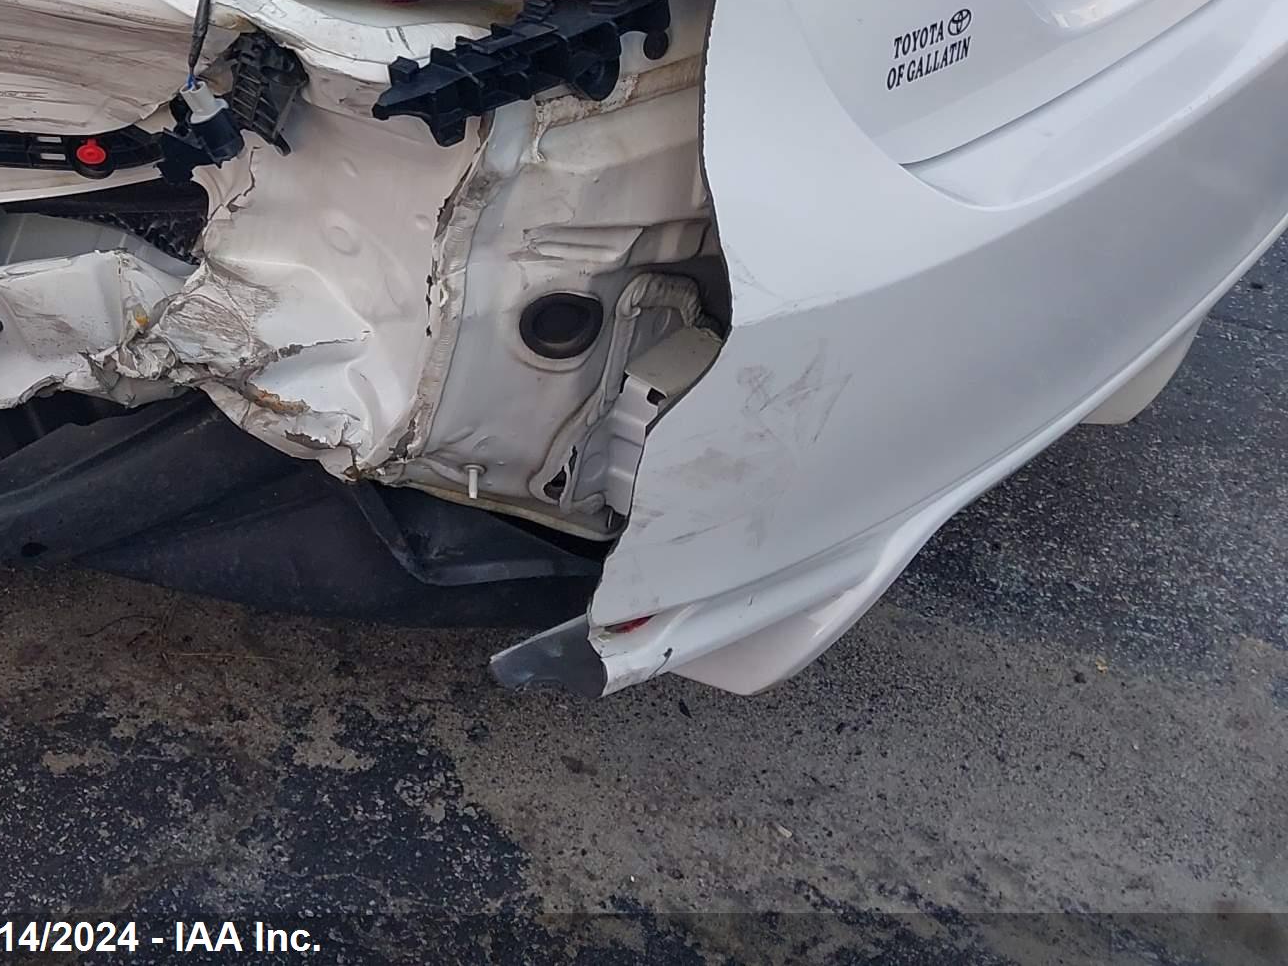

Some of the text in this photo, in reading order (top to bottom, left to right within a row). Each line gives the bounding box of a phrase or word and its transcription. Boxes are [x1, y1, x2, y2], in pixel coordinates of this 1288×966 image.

[893, 20, 945, 59] TOYOTA
[886, 36, 972, 90] OF GALLATIN
